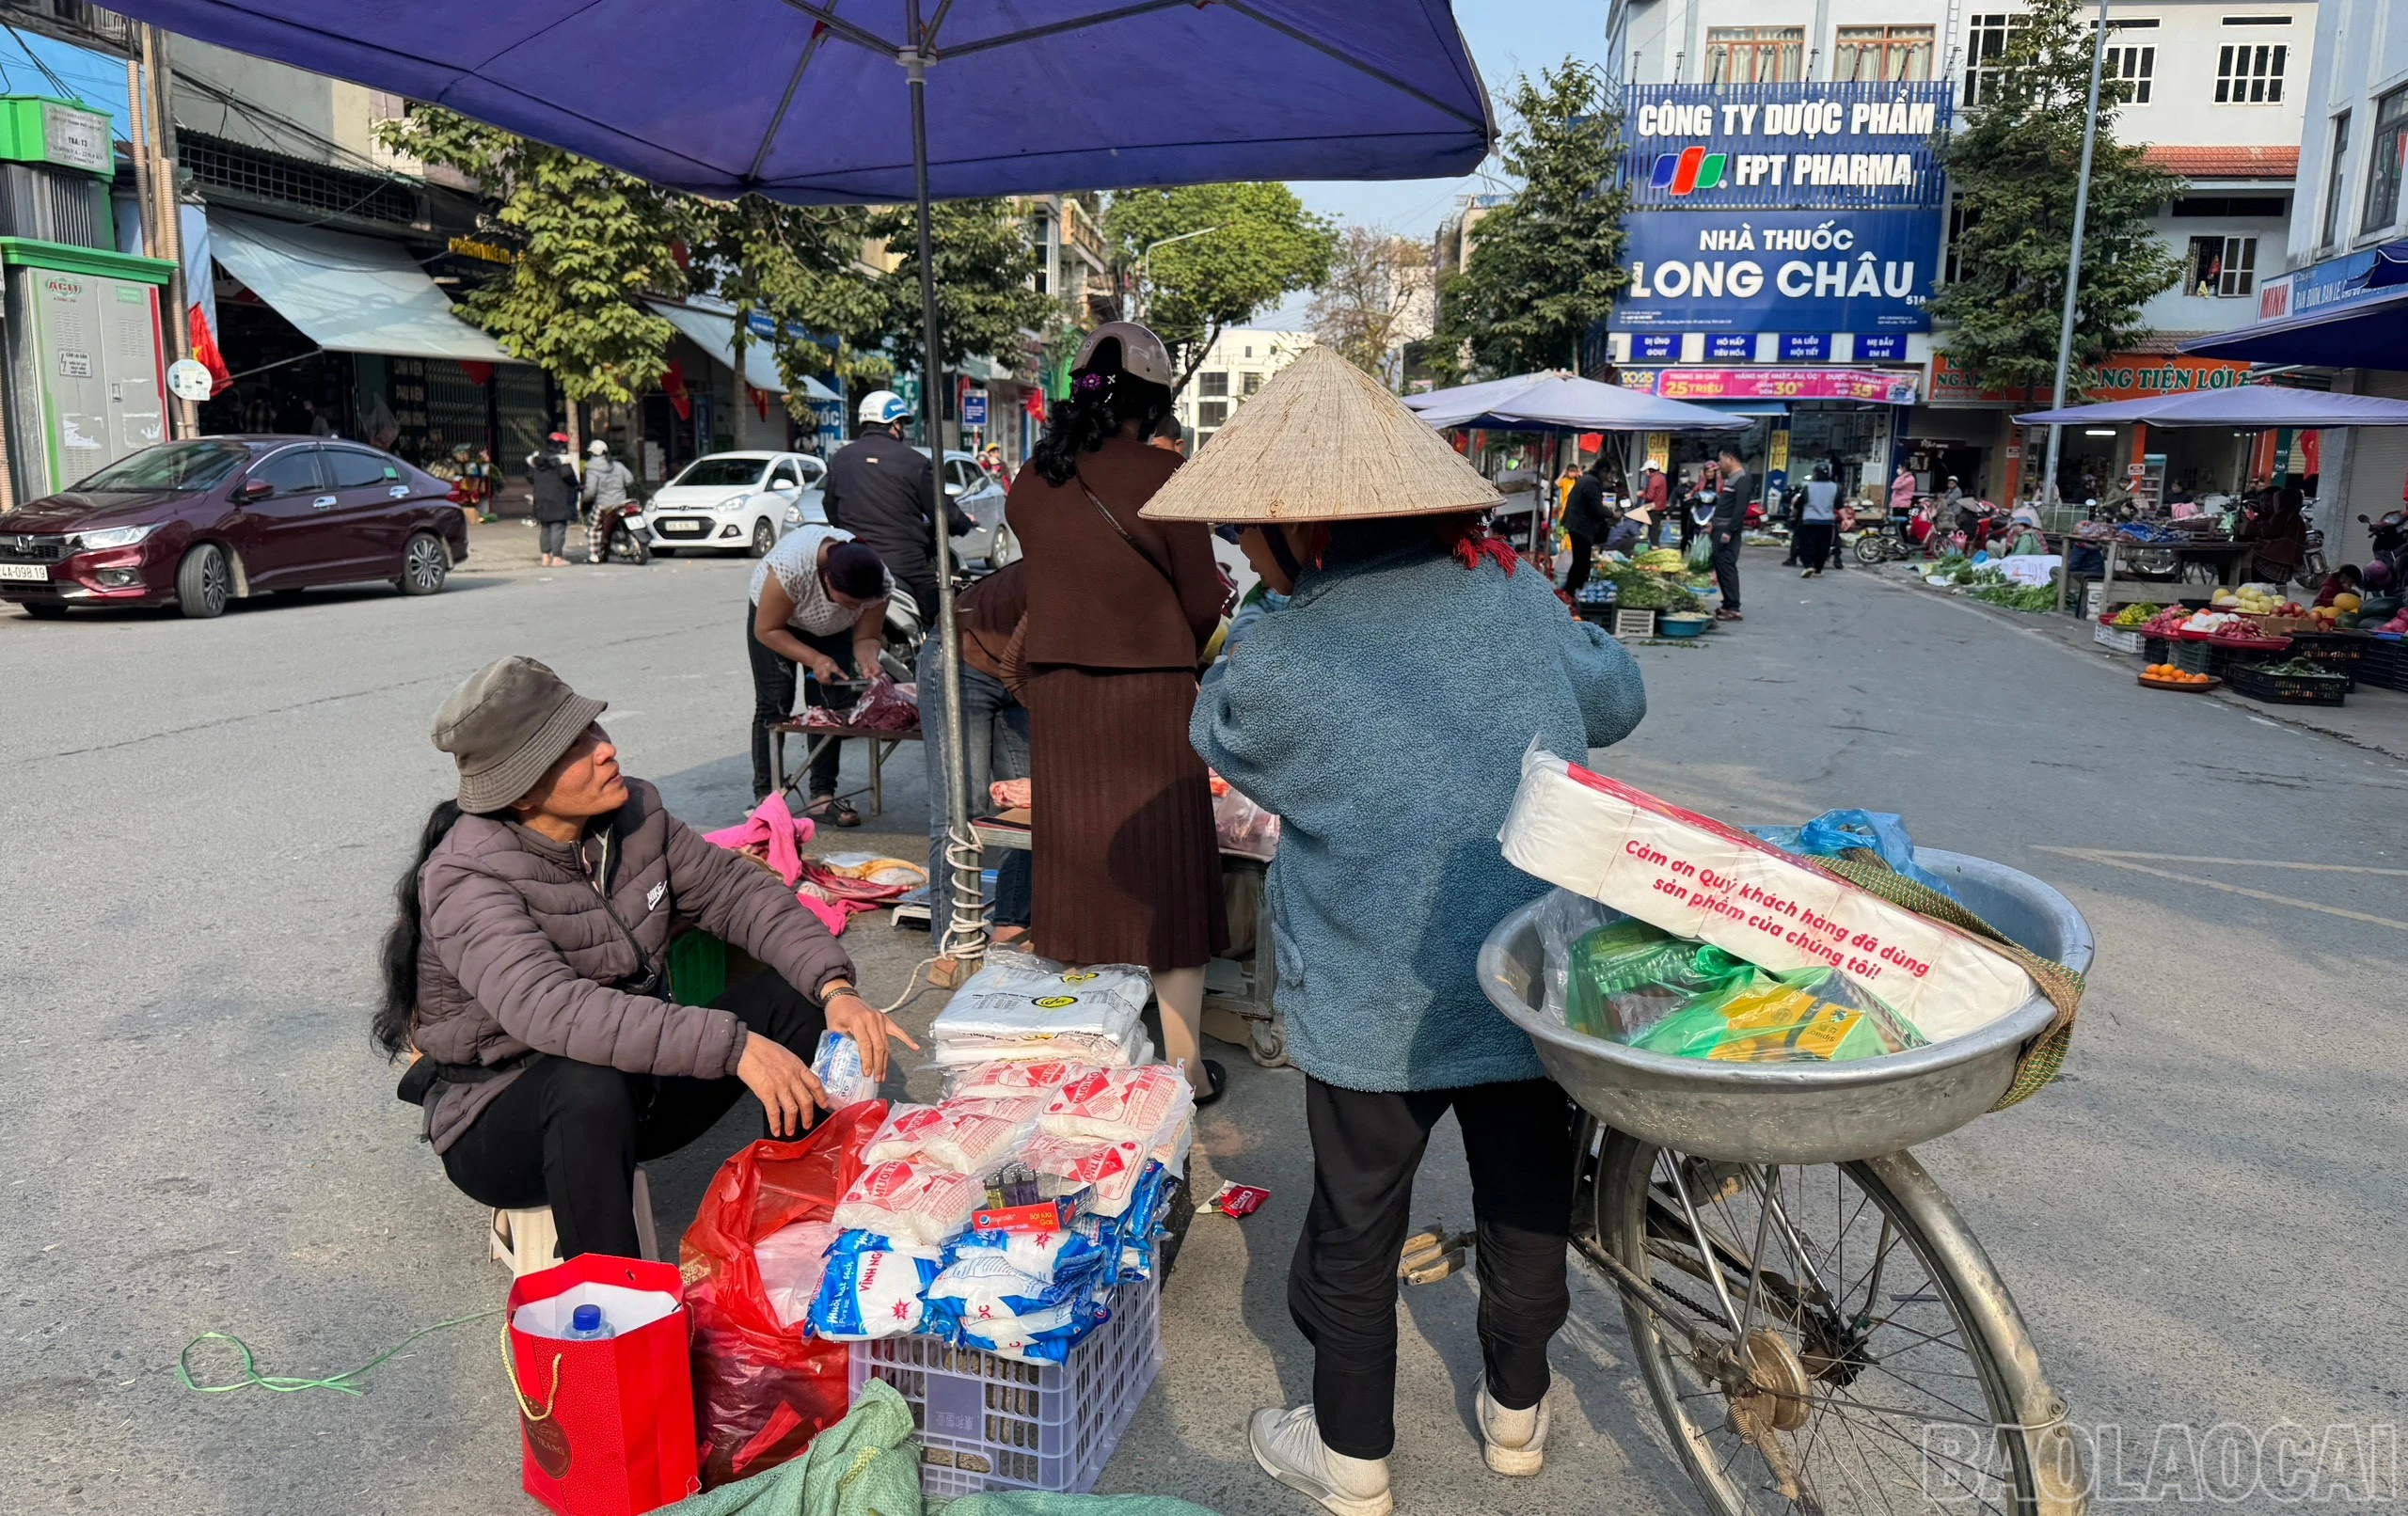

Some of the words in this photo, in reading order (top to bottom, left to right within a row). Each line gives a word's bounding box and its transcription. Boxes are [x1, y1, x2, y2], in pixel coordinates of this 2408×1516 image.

[1638, 99, 1712, 136] CÔNG
[1721, 103, 1759, 135] TY
[1764, 99, 1843, 139] DƯỢC
[1850, 88, 1935, 134] PHẨM
[1736, 154, 1786, 185] FPT
[1793, 153, 1911, 185] PHARMA
[1700, 223, 1754, 251] NHÀ
[1763, 219, 1854, 251] THUỐC
[1629, 261, 1764, 298] LONG
[1777, 250, 1914, 298] CHÂU
[2259, 284, 2289, 320] MINH
[1666, 381, 1688, 395] 25
[2137, 362, 2192, 395] TIỆN
[646, 881, 662, 903] NIKE
[1625, 840, 1668, 866] Cảm
[1671, 860, 1695, 877] ơn
[1699, 869, 1738, 894] Quý
[1738, 883, 1798, 918] khách
[1799, 908, 1849, 942] hàng
[1851, 933, 1878, 953] đã
[1880, 946, 1929, 978] dùng
[1653, 878, 1687, 900] sản
[1687, 892, 1745, 920] phẩm
[1749, 915, 1783, 937] của
[1785, 930, 1844, 967] chúng
[1846, 956, 1882, 980] tôi!
[859, 1269, 877, 1292] VĨNH
